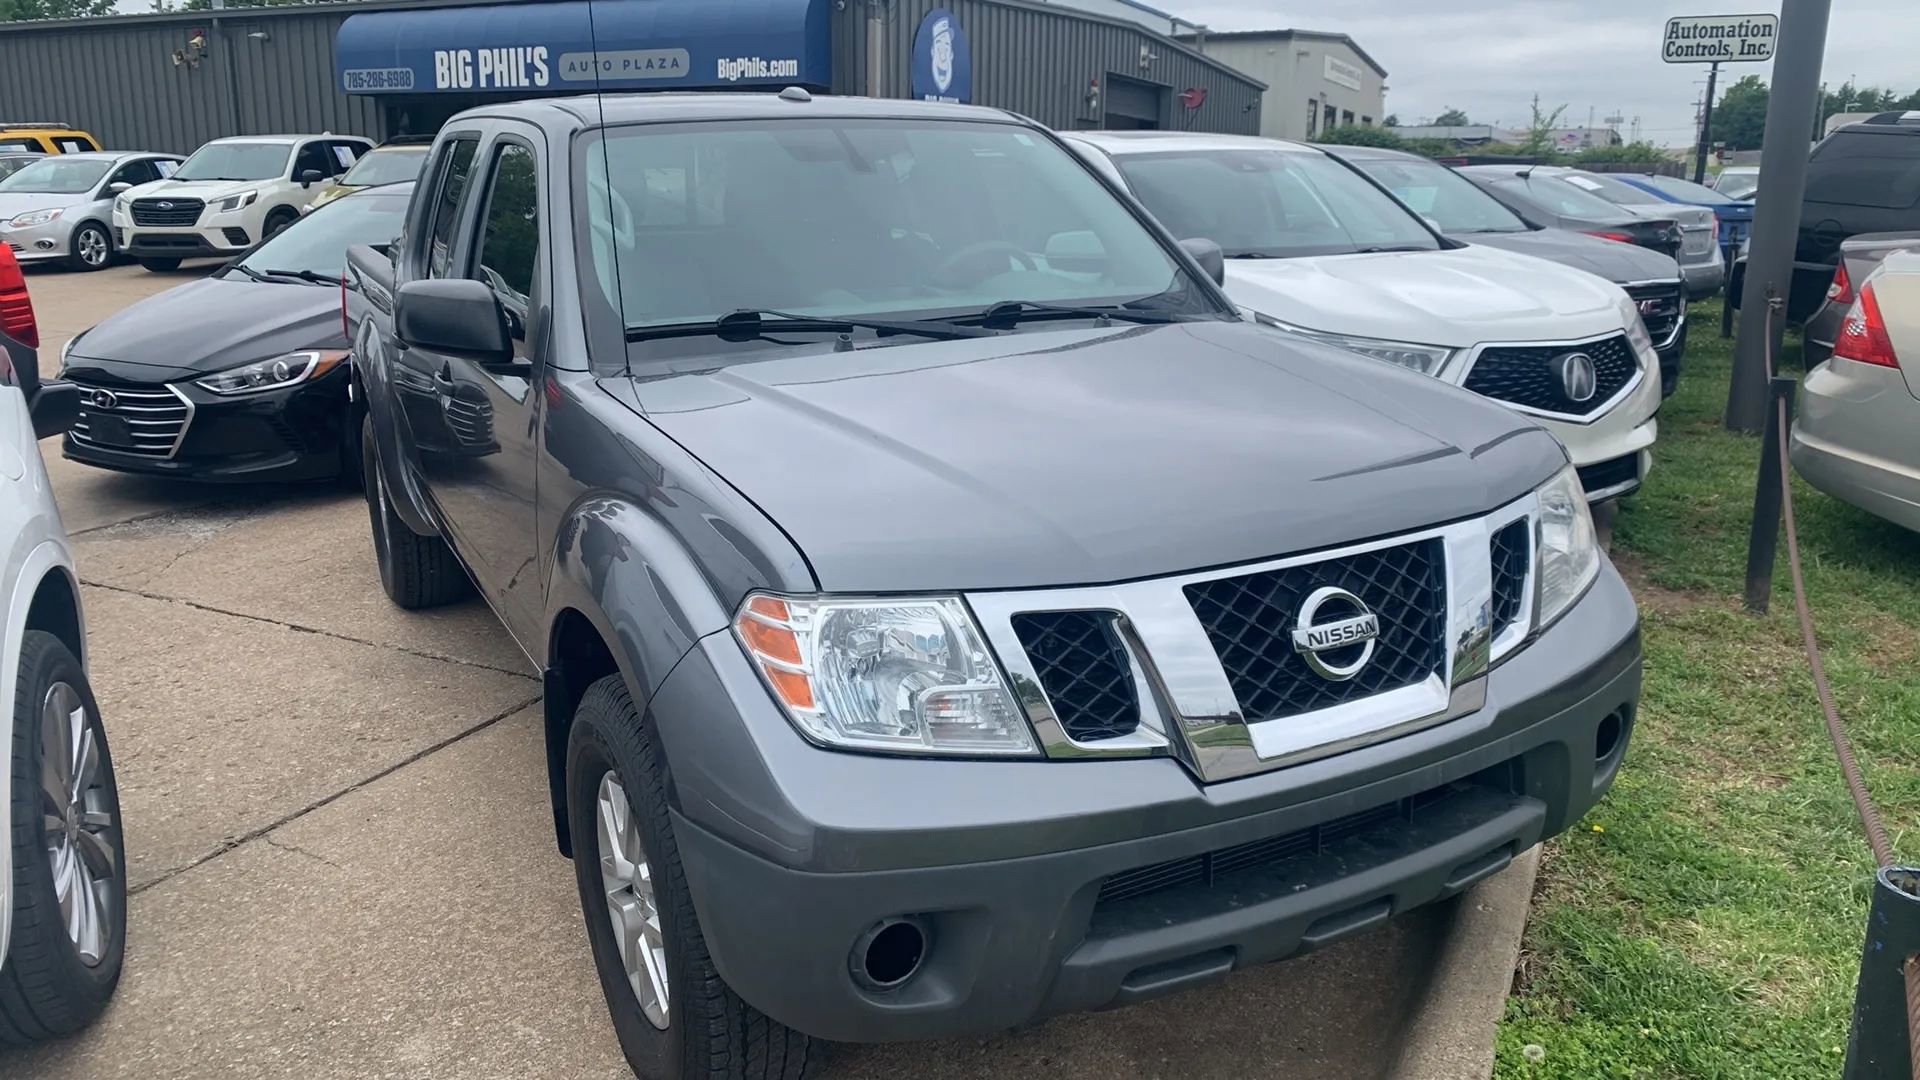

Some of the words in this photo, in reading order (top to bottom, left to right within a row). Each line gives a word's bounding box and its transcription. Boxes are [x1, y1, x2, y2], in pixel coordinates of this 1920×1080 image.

[1667, 20, 1773, 40] Automation
[1665, 40, 1734, 60] Controls,
[1739, 39, 1770, 56] Inc.
[346, 70, 411, 88] 785-286-6988
[434, 50, 472, 89] BIG
[478, 46, 549, 88] PHIL'S
[623, 57, 680, 70] PLAZA
[718, 57, 798, 82] BigPhils.com
[1307, 621, 1376, 647] NISSAN
